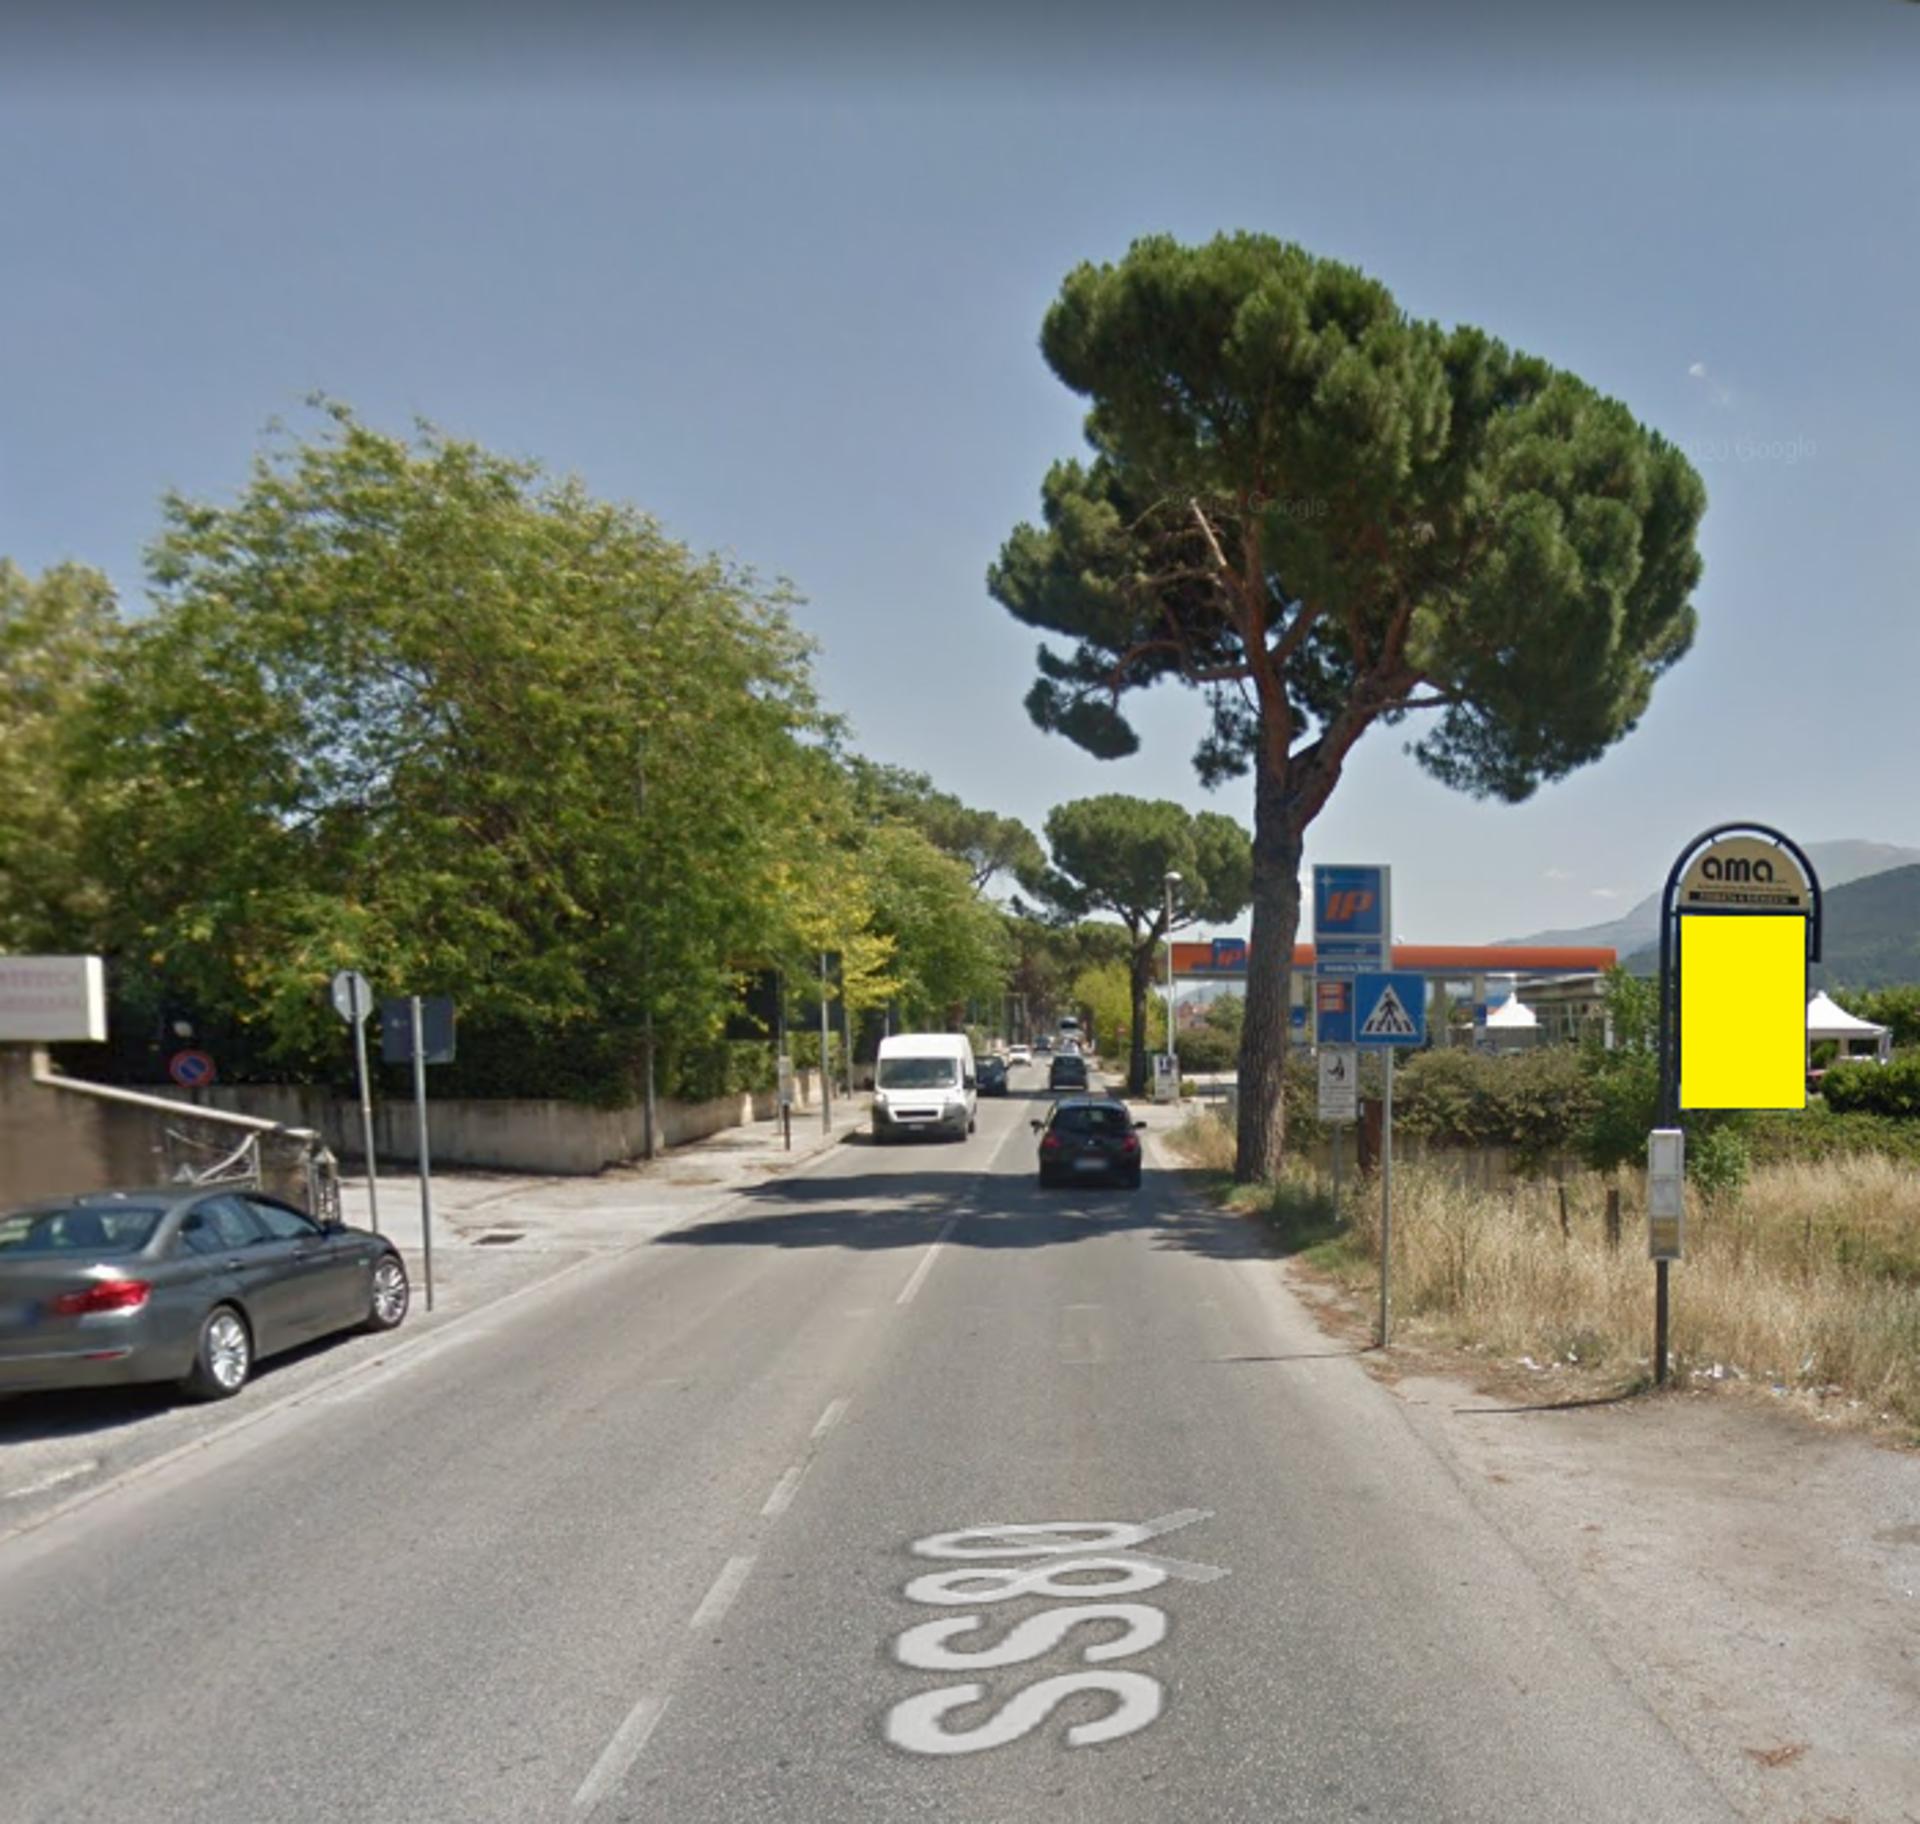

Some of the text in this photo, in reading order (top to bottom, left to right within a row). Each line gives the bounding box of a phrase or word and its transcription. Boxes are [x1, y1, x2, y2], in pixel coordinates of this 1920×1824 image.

[1701, 856, 1773, 882] ama
[1324, 890, 1376, 922] IP
[885, 1518, 1168, 1757] SS80
